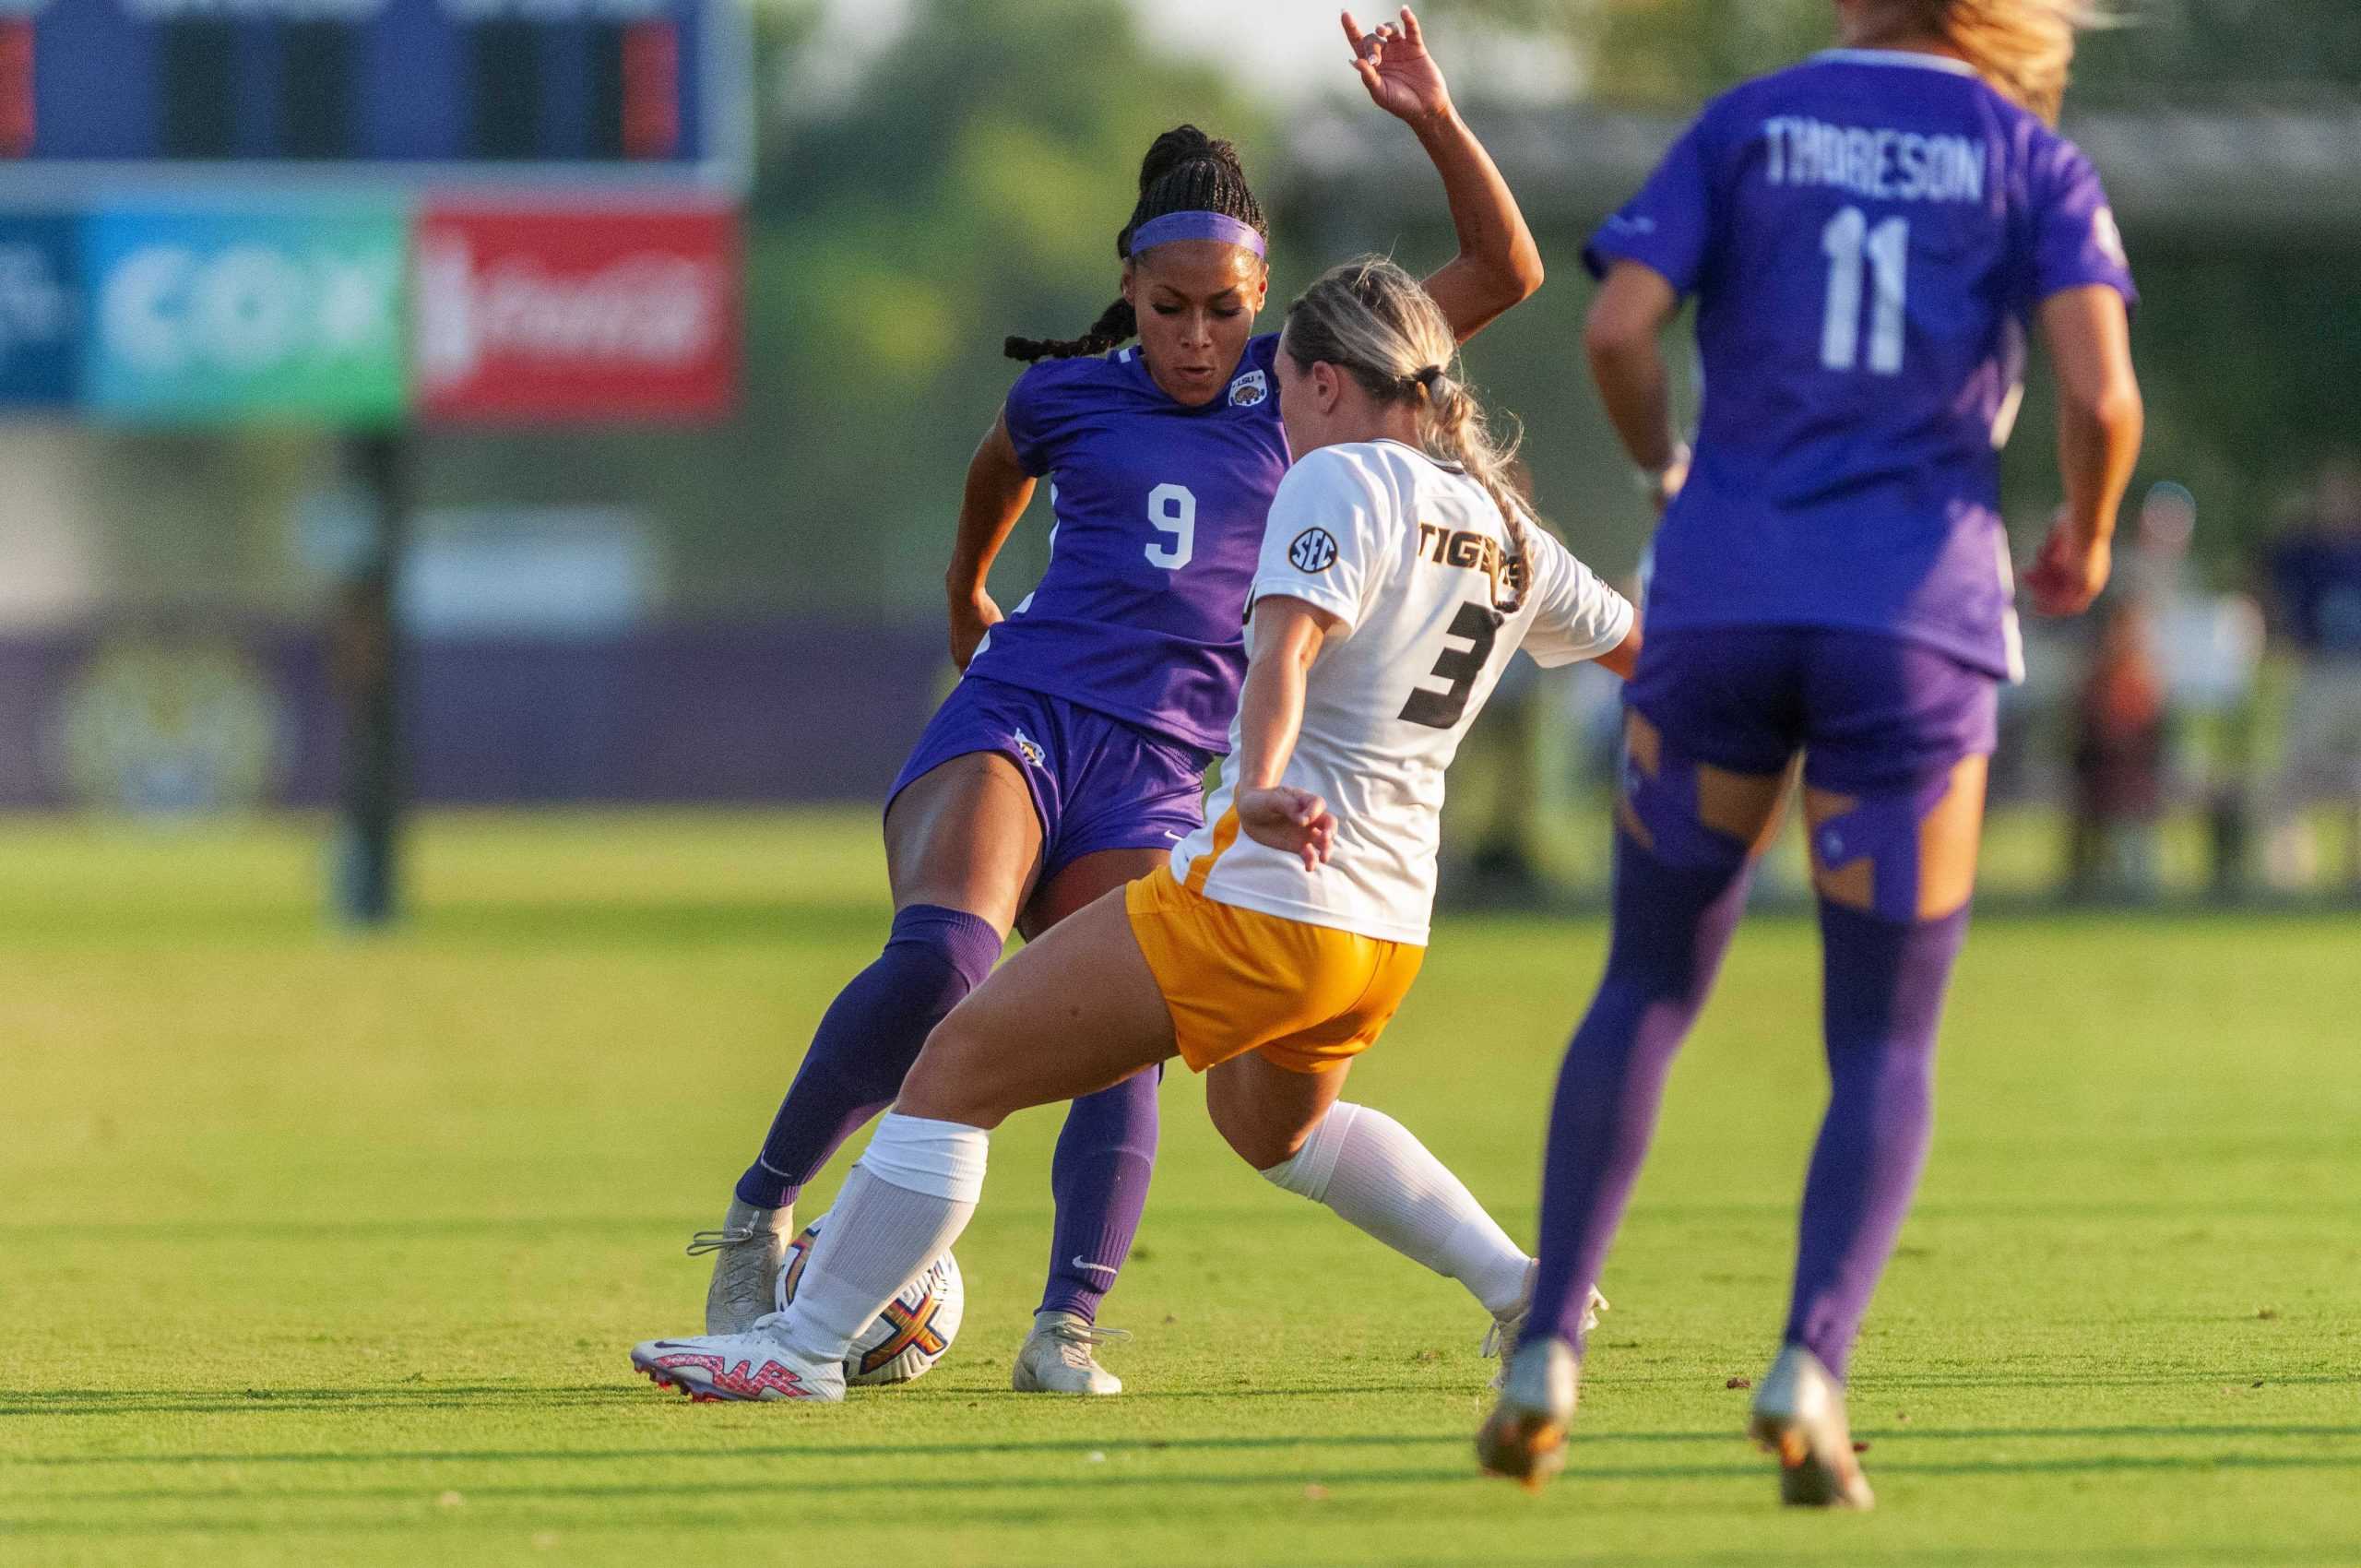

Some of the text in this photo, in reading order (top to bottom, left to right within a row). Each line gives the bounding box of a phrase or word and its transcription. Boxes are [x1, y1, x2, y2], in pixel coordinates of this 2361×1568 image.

[1762, 114, 1986, 204] THORESON
[1822, 207, 1910, 374] 11
[1145, 482, 1196, 570] 9
[1291, 529, 1335, 571] SEC
[1397, 600, 1497, 730] 3
